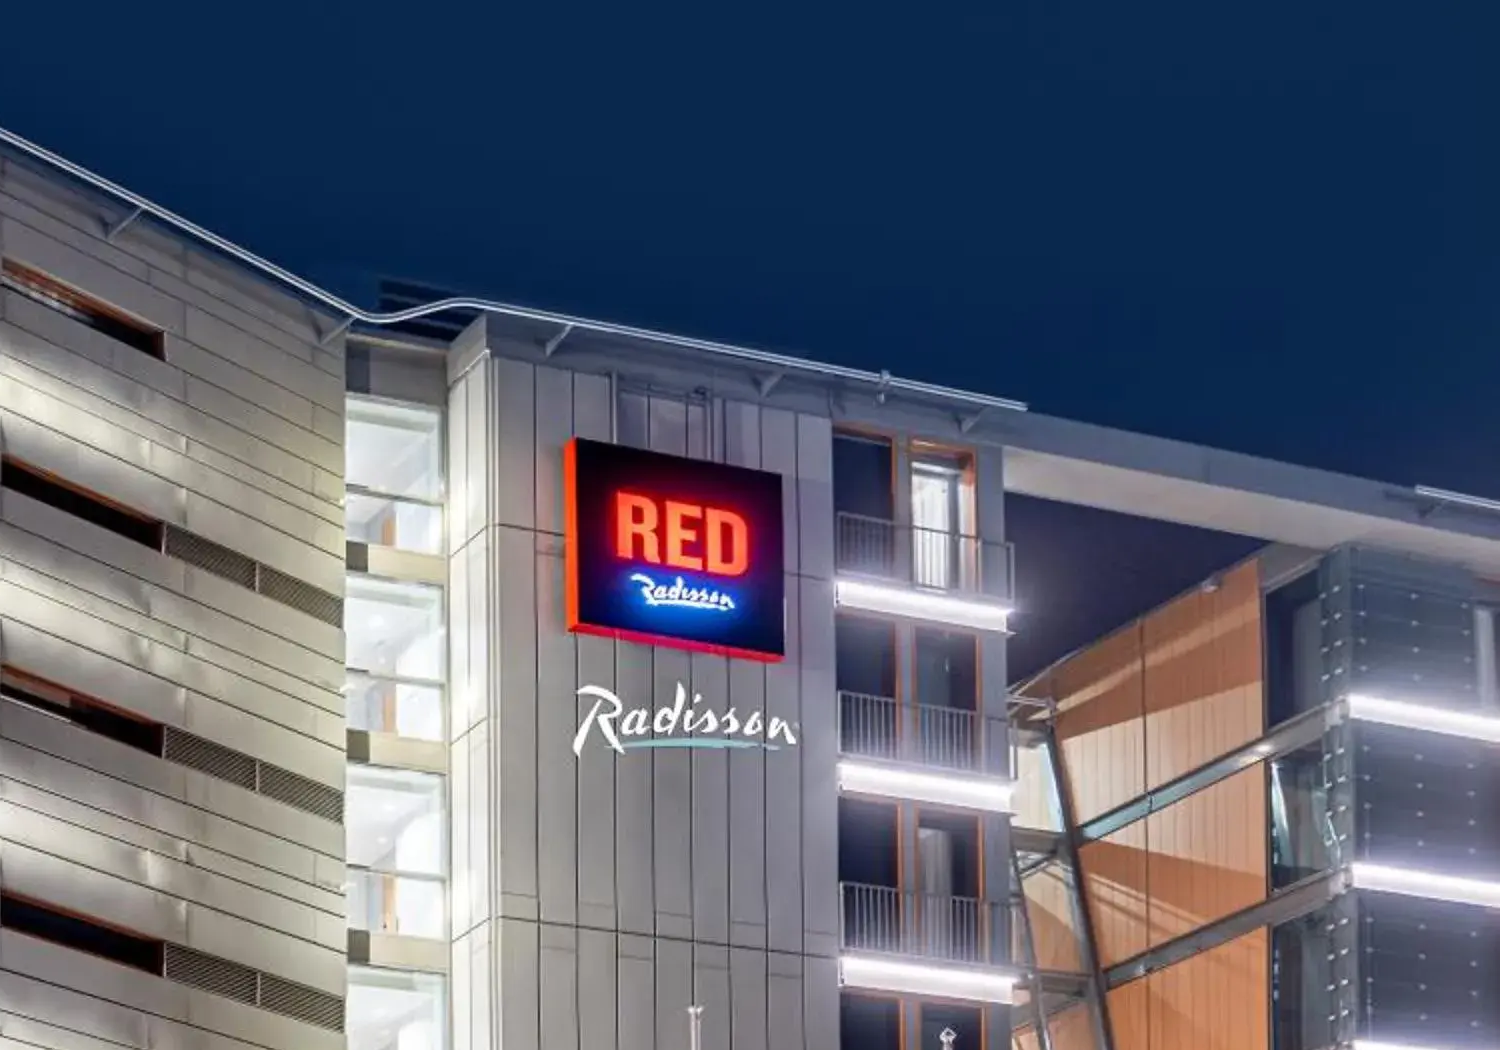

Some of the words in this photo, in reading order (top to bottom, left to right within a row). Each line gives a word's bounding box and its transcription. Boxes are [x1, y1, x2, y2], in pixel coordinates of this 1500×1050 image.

[615, 490, 749, 577] RED
[630, 573, 735, 610] Radisson
[572, 680, 797, 758] Radisson
